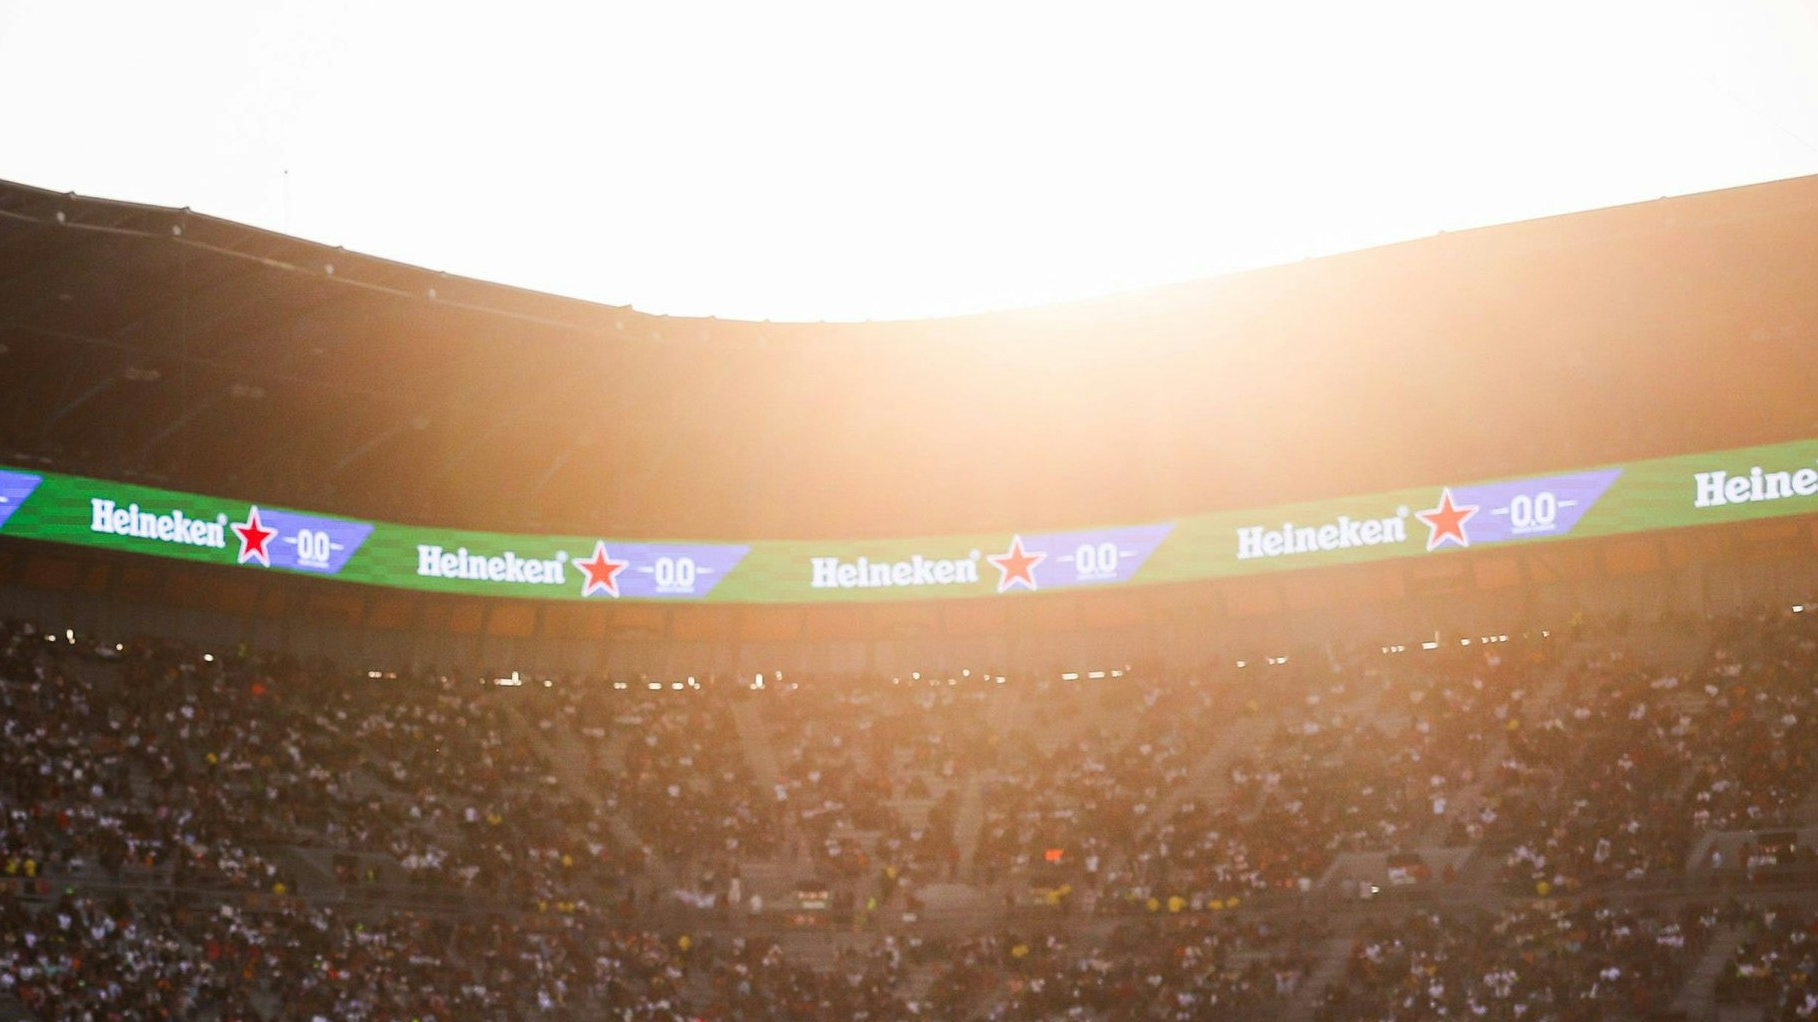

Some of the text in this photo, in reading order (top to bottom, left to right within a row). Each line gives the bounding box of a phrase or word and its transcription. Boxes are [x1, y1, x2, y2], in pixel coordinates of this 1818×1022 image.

[90, 498, 225, 548] Heineken
[1237, 516, 1407, 559] Heineken
[417, 545, 565, 584] Heineken
[810, 551, 978, 588] Heineken
